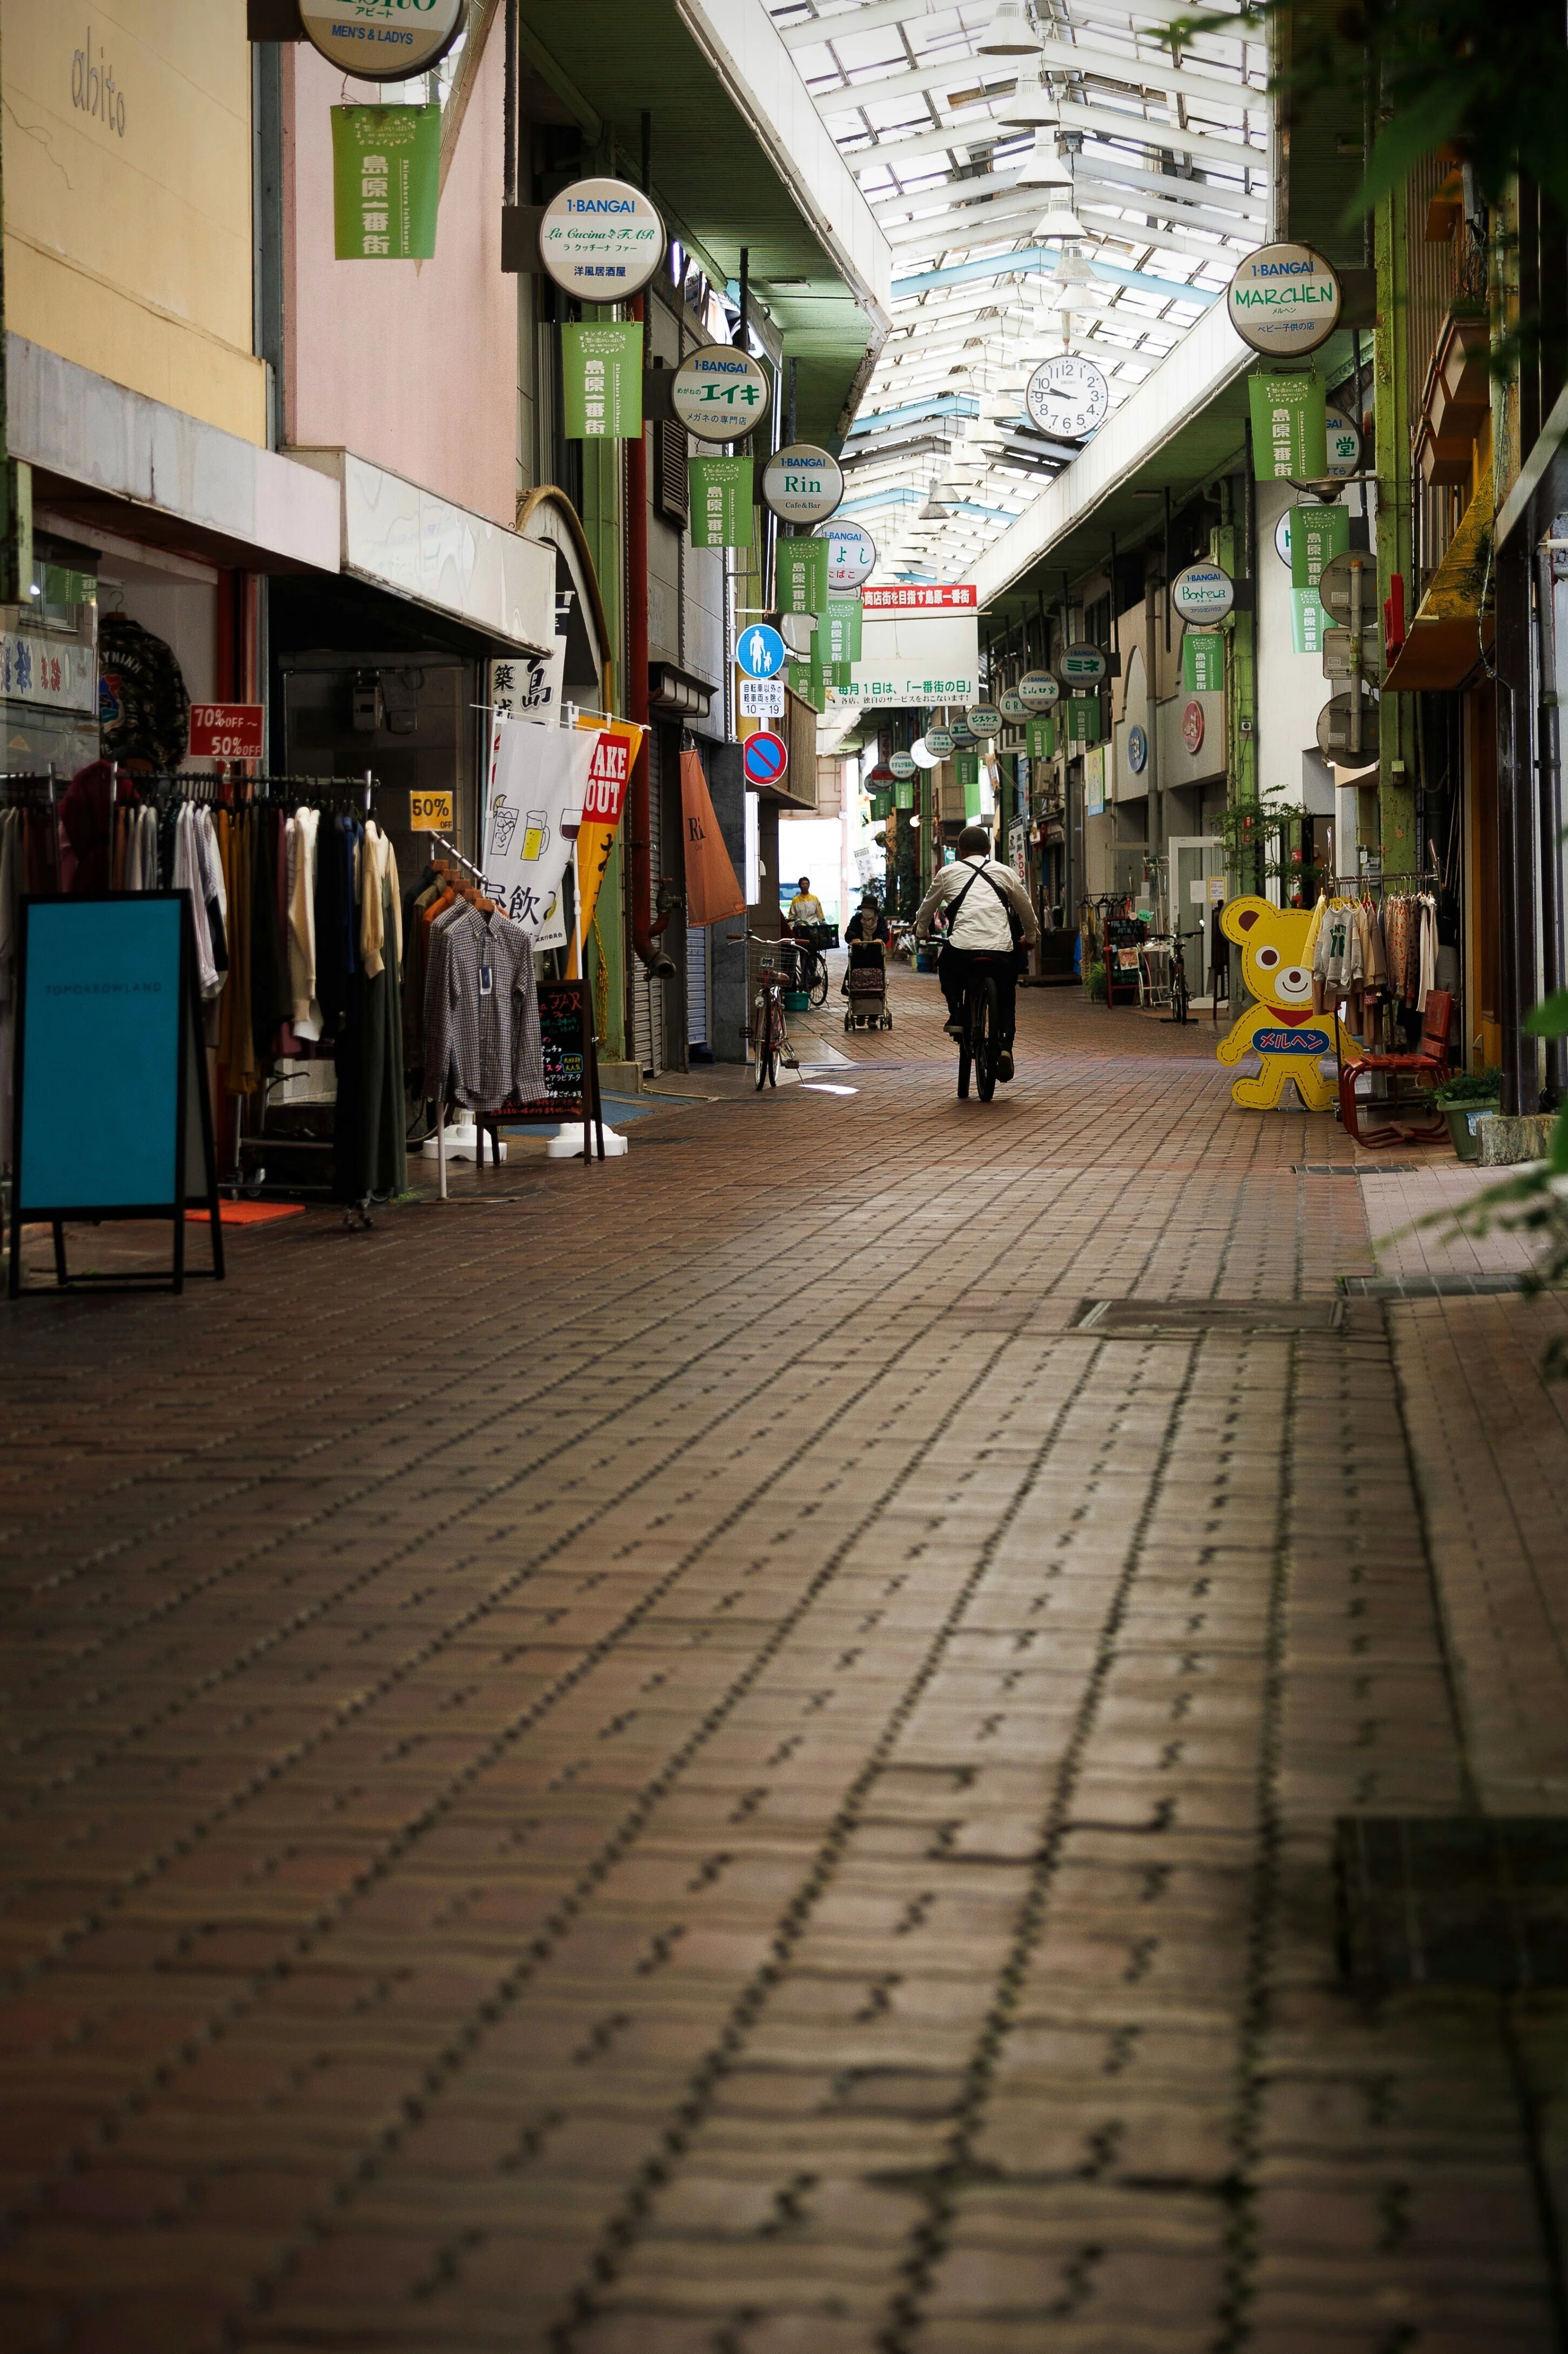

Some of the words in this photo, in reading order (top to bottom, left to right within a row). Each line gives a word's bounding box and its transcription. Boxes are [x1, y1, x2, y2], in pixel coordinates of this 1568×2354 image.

[355, 6, 393, 18] アビート
[332, 25, 365, 39] MEN'S
[367, 30, 375, 40] &
[378, 30, 413, 45] LADYS
[72, 26, 124, 138] abito
[361, 155, 390, 255] 島原一番街
[545, 228, 562, 240] La
[567, 228, 606, 239] Cucina
[617, 229, 655, 240] FAR
[574, 266, 626, 277] 洋風居酒屋
[1236, 282, 1332, 308] MARCHEN
[1258, 322, 1315, 332] ベビー子供の店
[1050, 368, 1058, 378] 11
[1062, 365, 1074, 376] 12
[1081, 368, 1082, 378] 1
[1038, 378, 1050, 389] 10
[1087, 377, 1095, 387] 2
[585, 360, 606, 434] 島原一番街
[700, 384, 759, 405] エイキ
[1035, 392, 1043, 403] 9
[1091, 391, 1099, 402] 3
[1040, 404, 1048, 415] 8
[1087, 404, 1095, 414] 4
[687, 413, 747, 425] メガネの専門店
[1050, 415, 1058, 426] 7
[1063, 418, 1071, 429] 6
[1077, 414, 1085, 425] 5
[1272, 409, 1292, 477] 島原一番街
[1336, 436, 1355, 457] 堂
[784, 476, 822, 492] Rin
[707, 486, 723, 544] 島原一番街
[1307, 532, 1322, 585] 島原一番街
[792, 563, 806, 611] 島原一番街
[1304, 607, 1317, 651] 島原一番街
[831, 620, 843, 661] 島原一番街
[1067, 659, 1100, 672] ミネ
[1196, 653, 1207, 690] 島原一番街
[744, 684, 782, 693] 自転車以外の
[744, 694, 781, 703] 軽車両を除く
[591, 744, 627, 780] AKE
[585, 778, 620, 814] OUT
[413, 798, 449, 817] 50%
[440, 821, 453, 829] OFF
[1261, 1033, 1323, 1049] メルヘン
